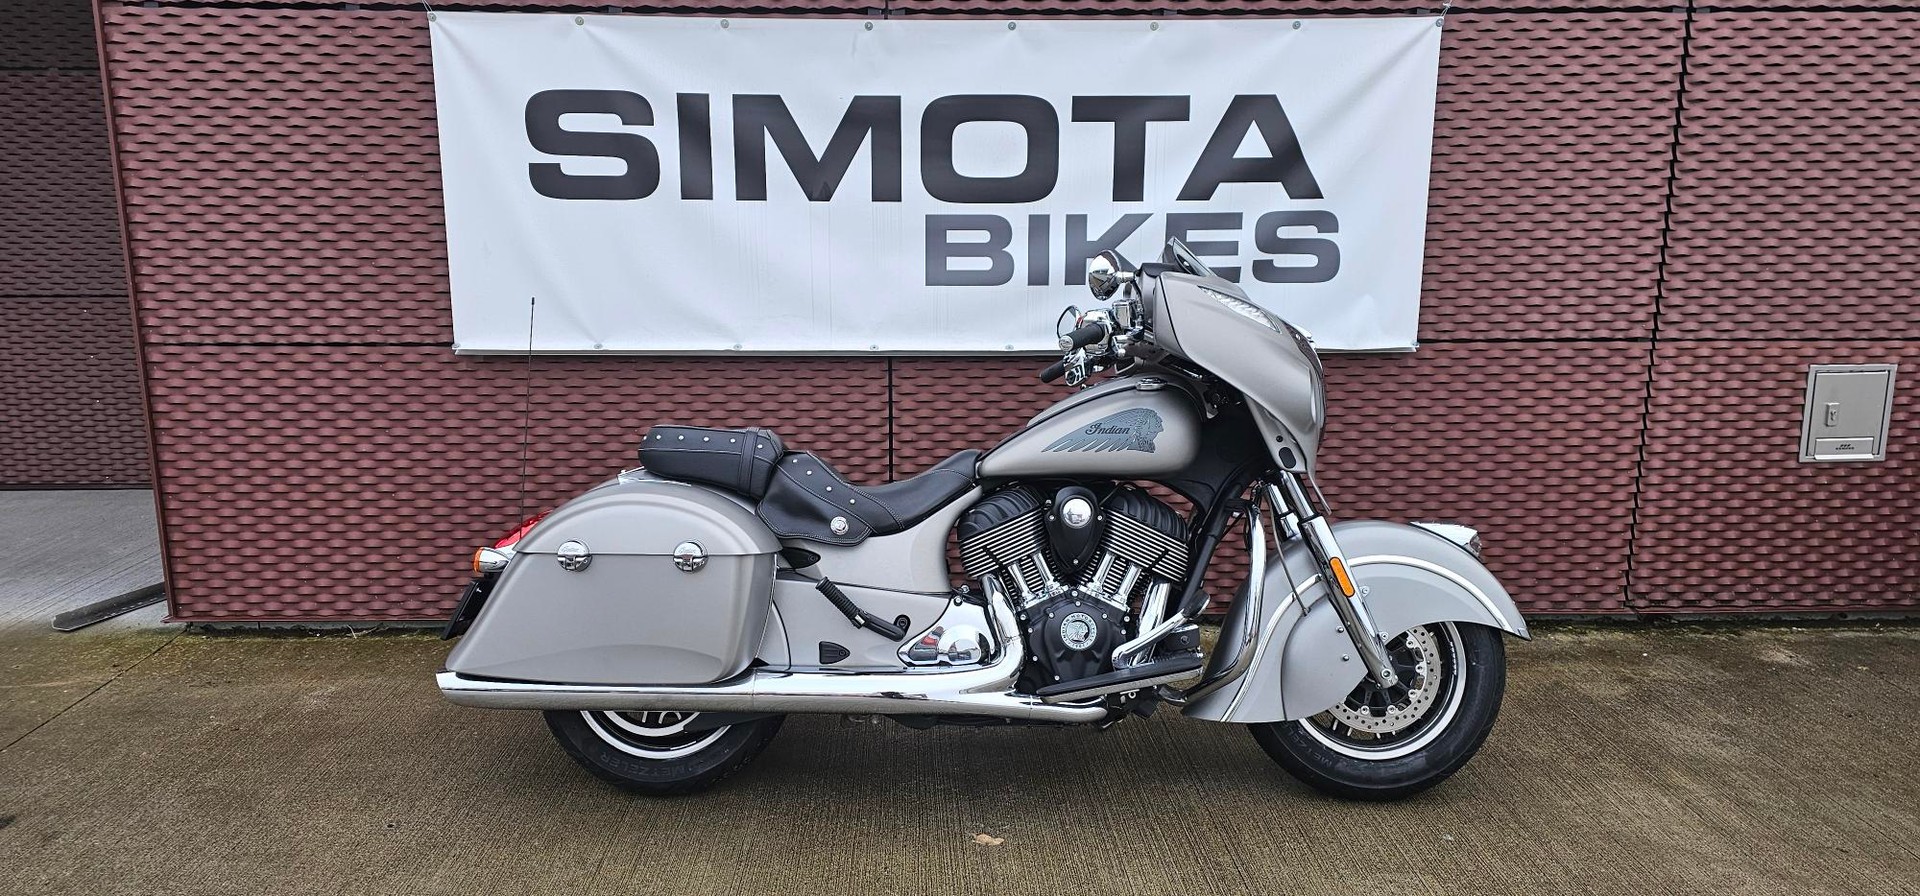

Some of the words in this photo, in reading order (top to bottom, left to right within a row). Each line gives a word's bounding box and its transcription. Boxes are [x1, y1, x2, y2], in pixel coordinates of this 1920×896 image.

[525, 90, 1323, 203] SIMOTA
[926, 211, 1340, 286] BIKES
[1085, 422, 1131, 435] Indian
